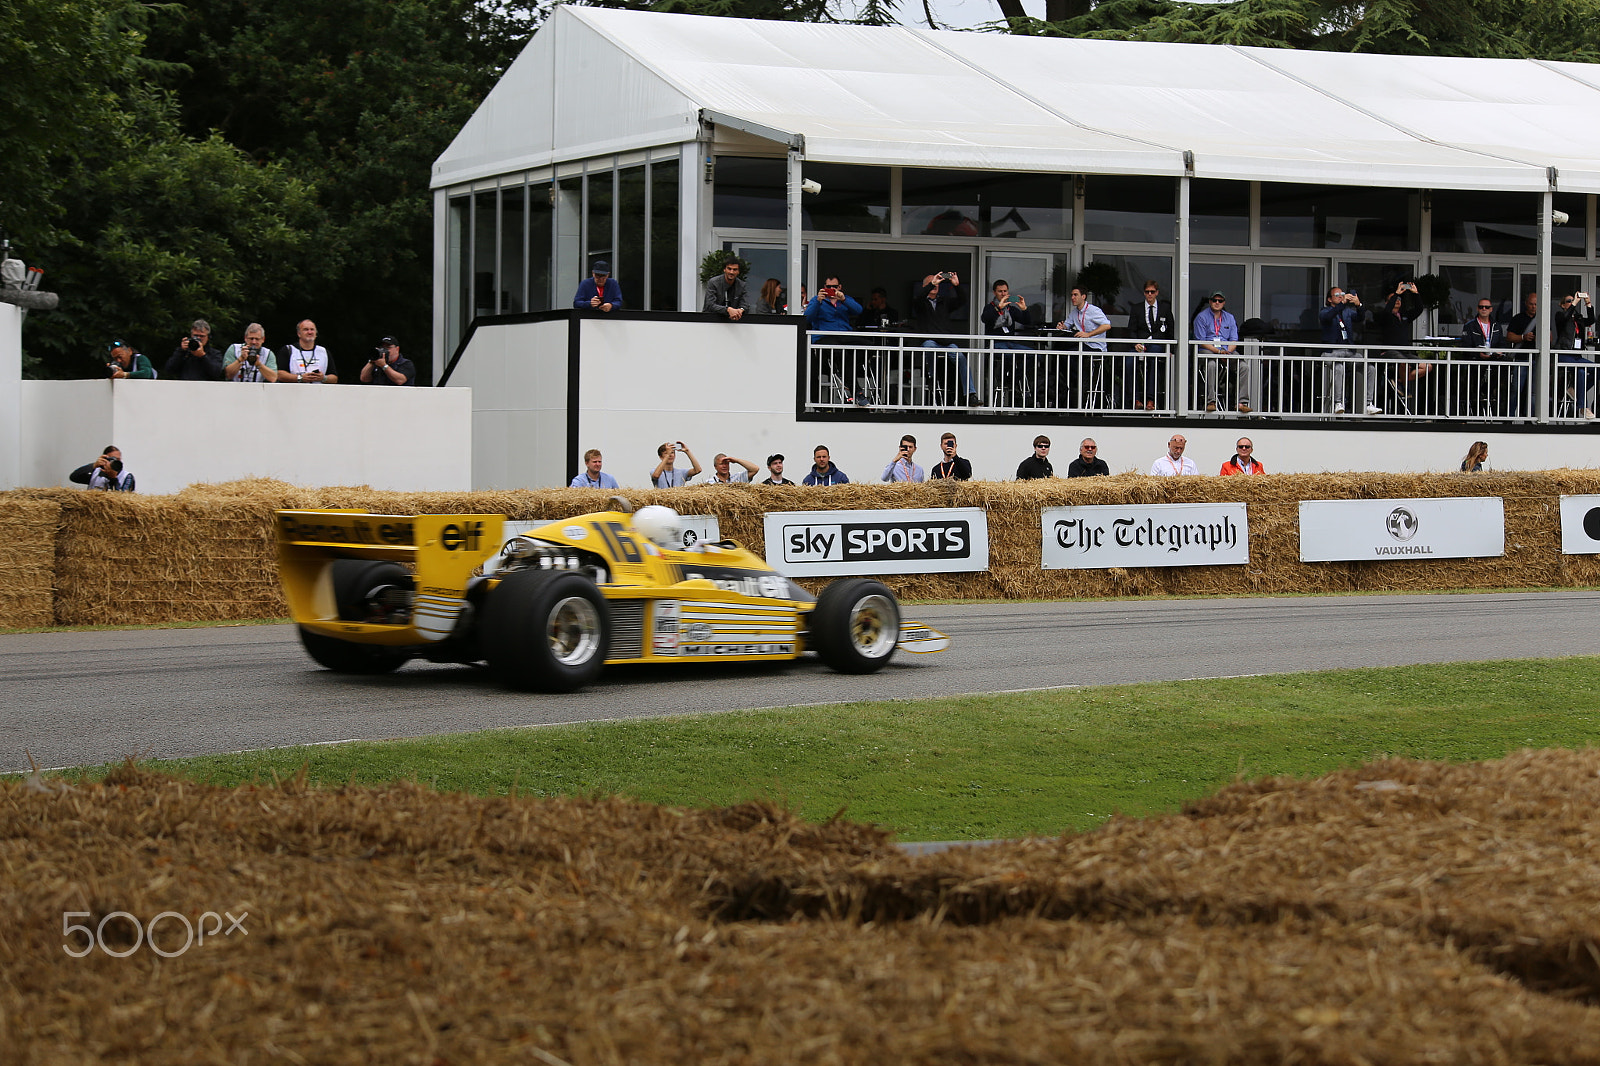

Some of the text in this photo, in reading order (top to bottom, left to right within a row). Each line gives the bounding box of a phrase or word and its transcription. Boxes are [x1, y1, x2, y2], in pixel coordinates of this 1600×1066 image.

[442, 521, 485, 551] elf
[590, 521, 643, 563] 16
[790, 527, 964, 559] sky SPORTS
[1054, 516, 1237, 553] The Telegraph
[1375, 546, 1433, 555] VAUXHALL
[683, 645, 790, 655] MICHELIN
